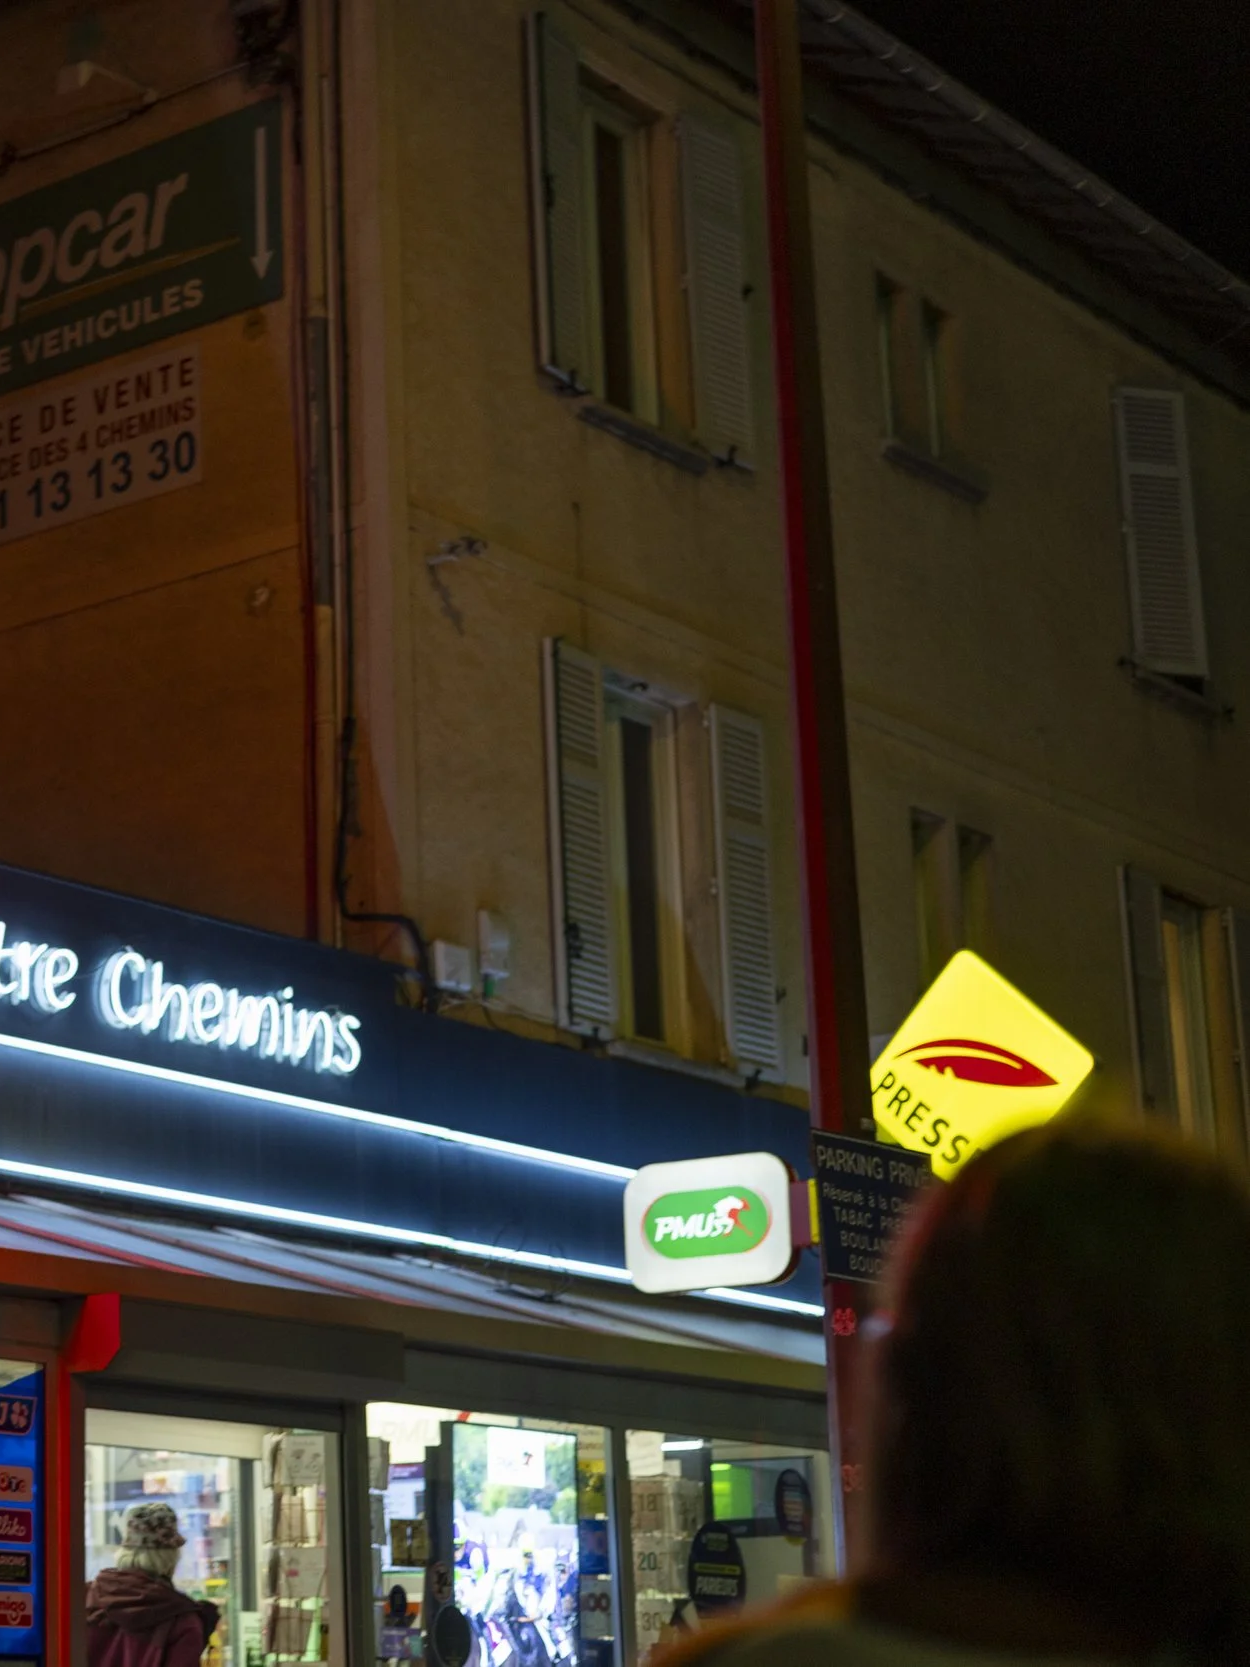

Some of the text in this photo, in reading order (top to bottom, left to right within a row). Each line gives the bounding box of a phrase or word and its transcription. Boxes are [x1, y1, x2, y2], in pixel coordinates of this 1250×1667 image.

[20, 278, 204, 365] VEHICULES
[39, 396, 77, 433] DE
[93, 356, 195, 415] VENTE
[28, 437, 69, 471] DES
[75, 431, 89, 455] 4
[95, 396, 196, 449] CHEMINS
[26, 469, 72, 519] 13
[87, 450, 132, 500] 13
[148, 430, 196, 482] 30
[100, 944, 362, 1076] Chemins
[871, 1071, 972, 1165] PRESS
[815, 1144, 884, 1180] PARKING
[653, 1212, 717, 1243] PMU
[833, 1205, 874, 1229] TABAC
